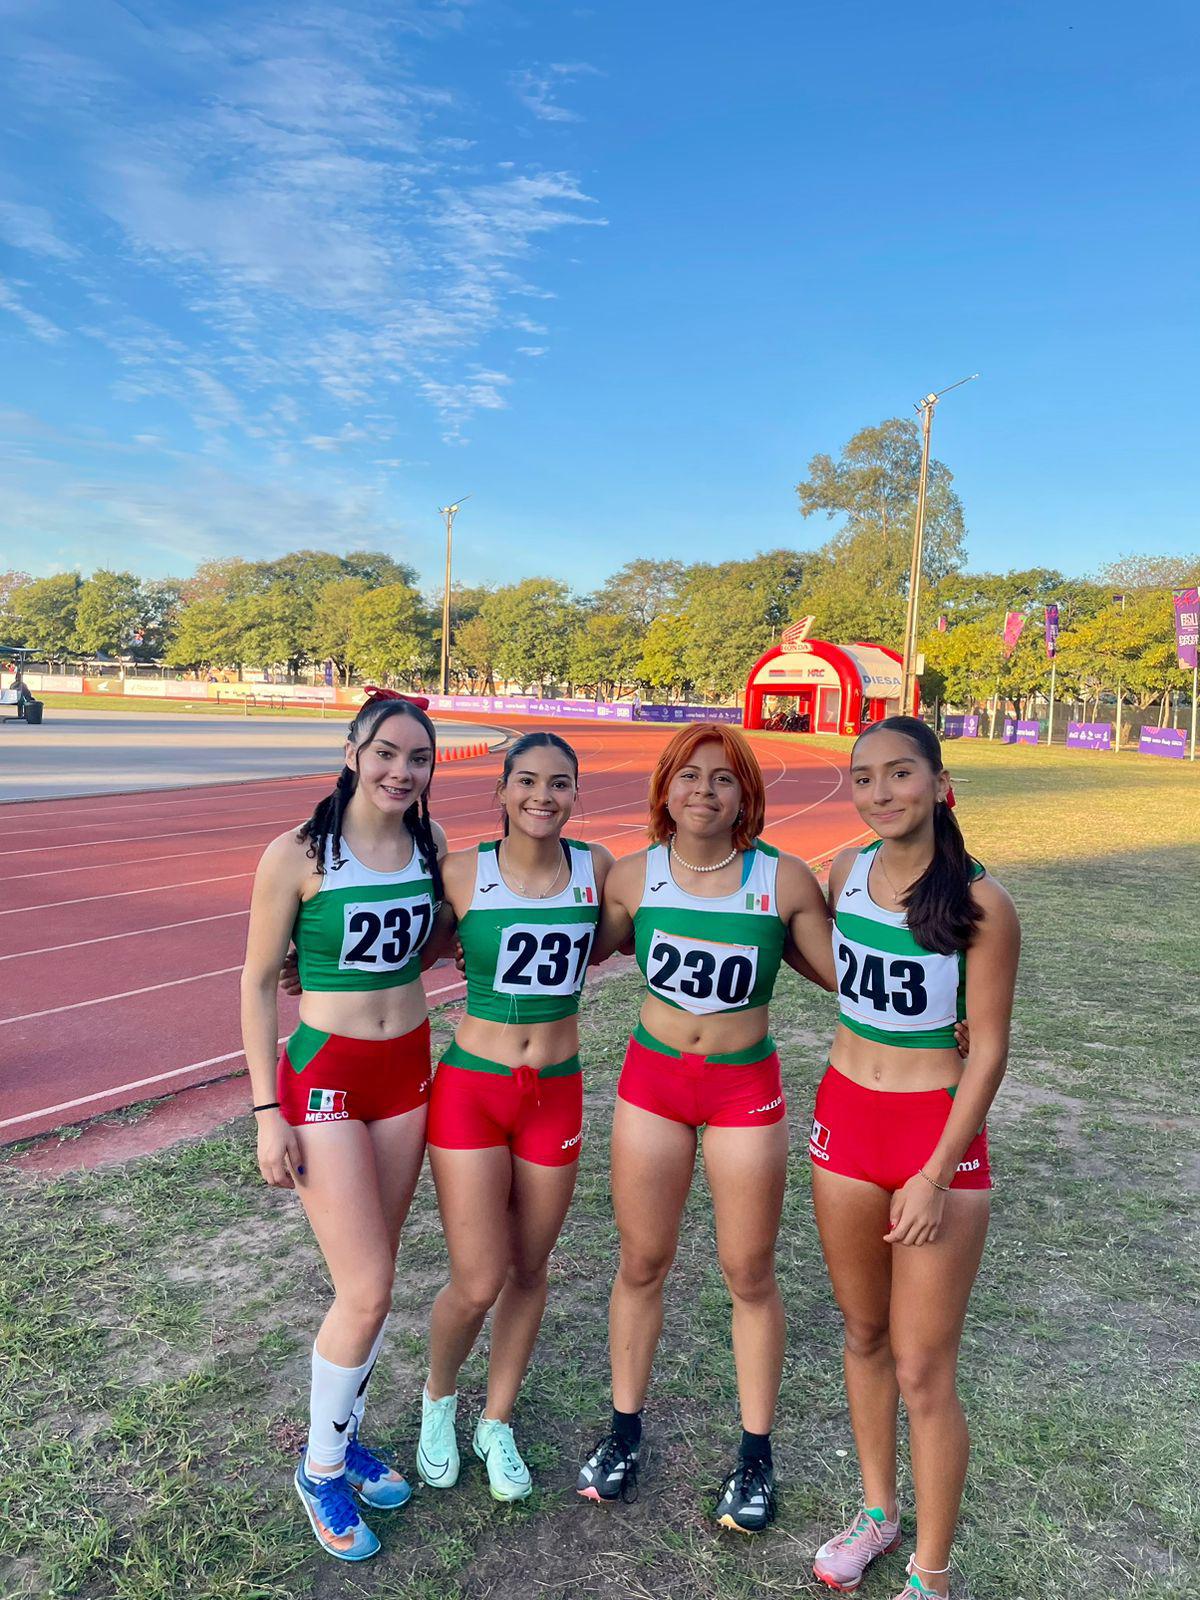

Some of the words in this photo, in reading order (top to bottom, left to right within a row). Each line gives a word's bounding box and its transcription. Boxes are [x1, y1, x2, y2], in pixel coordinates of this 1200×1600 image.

[862, 675, 902, 685] DIESA
[344, 903, 433, 964] 237
[501, 930, 591, 987] 231
[649, 941, 753, 1005] 230
[838, 942, 928, 1017] 243
[956, 1158, 981, 1172] ma
